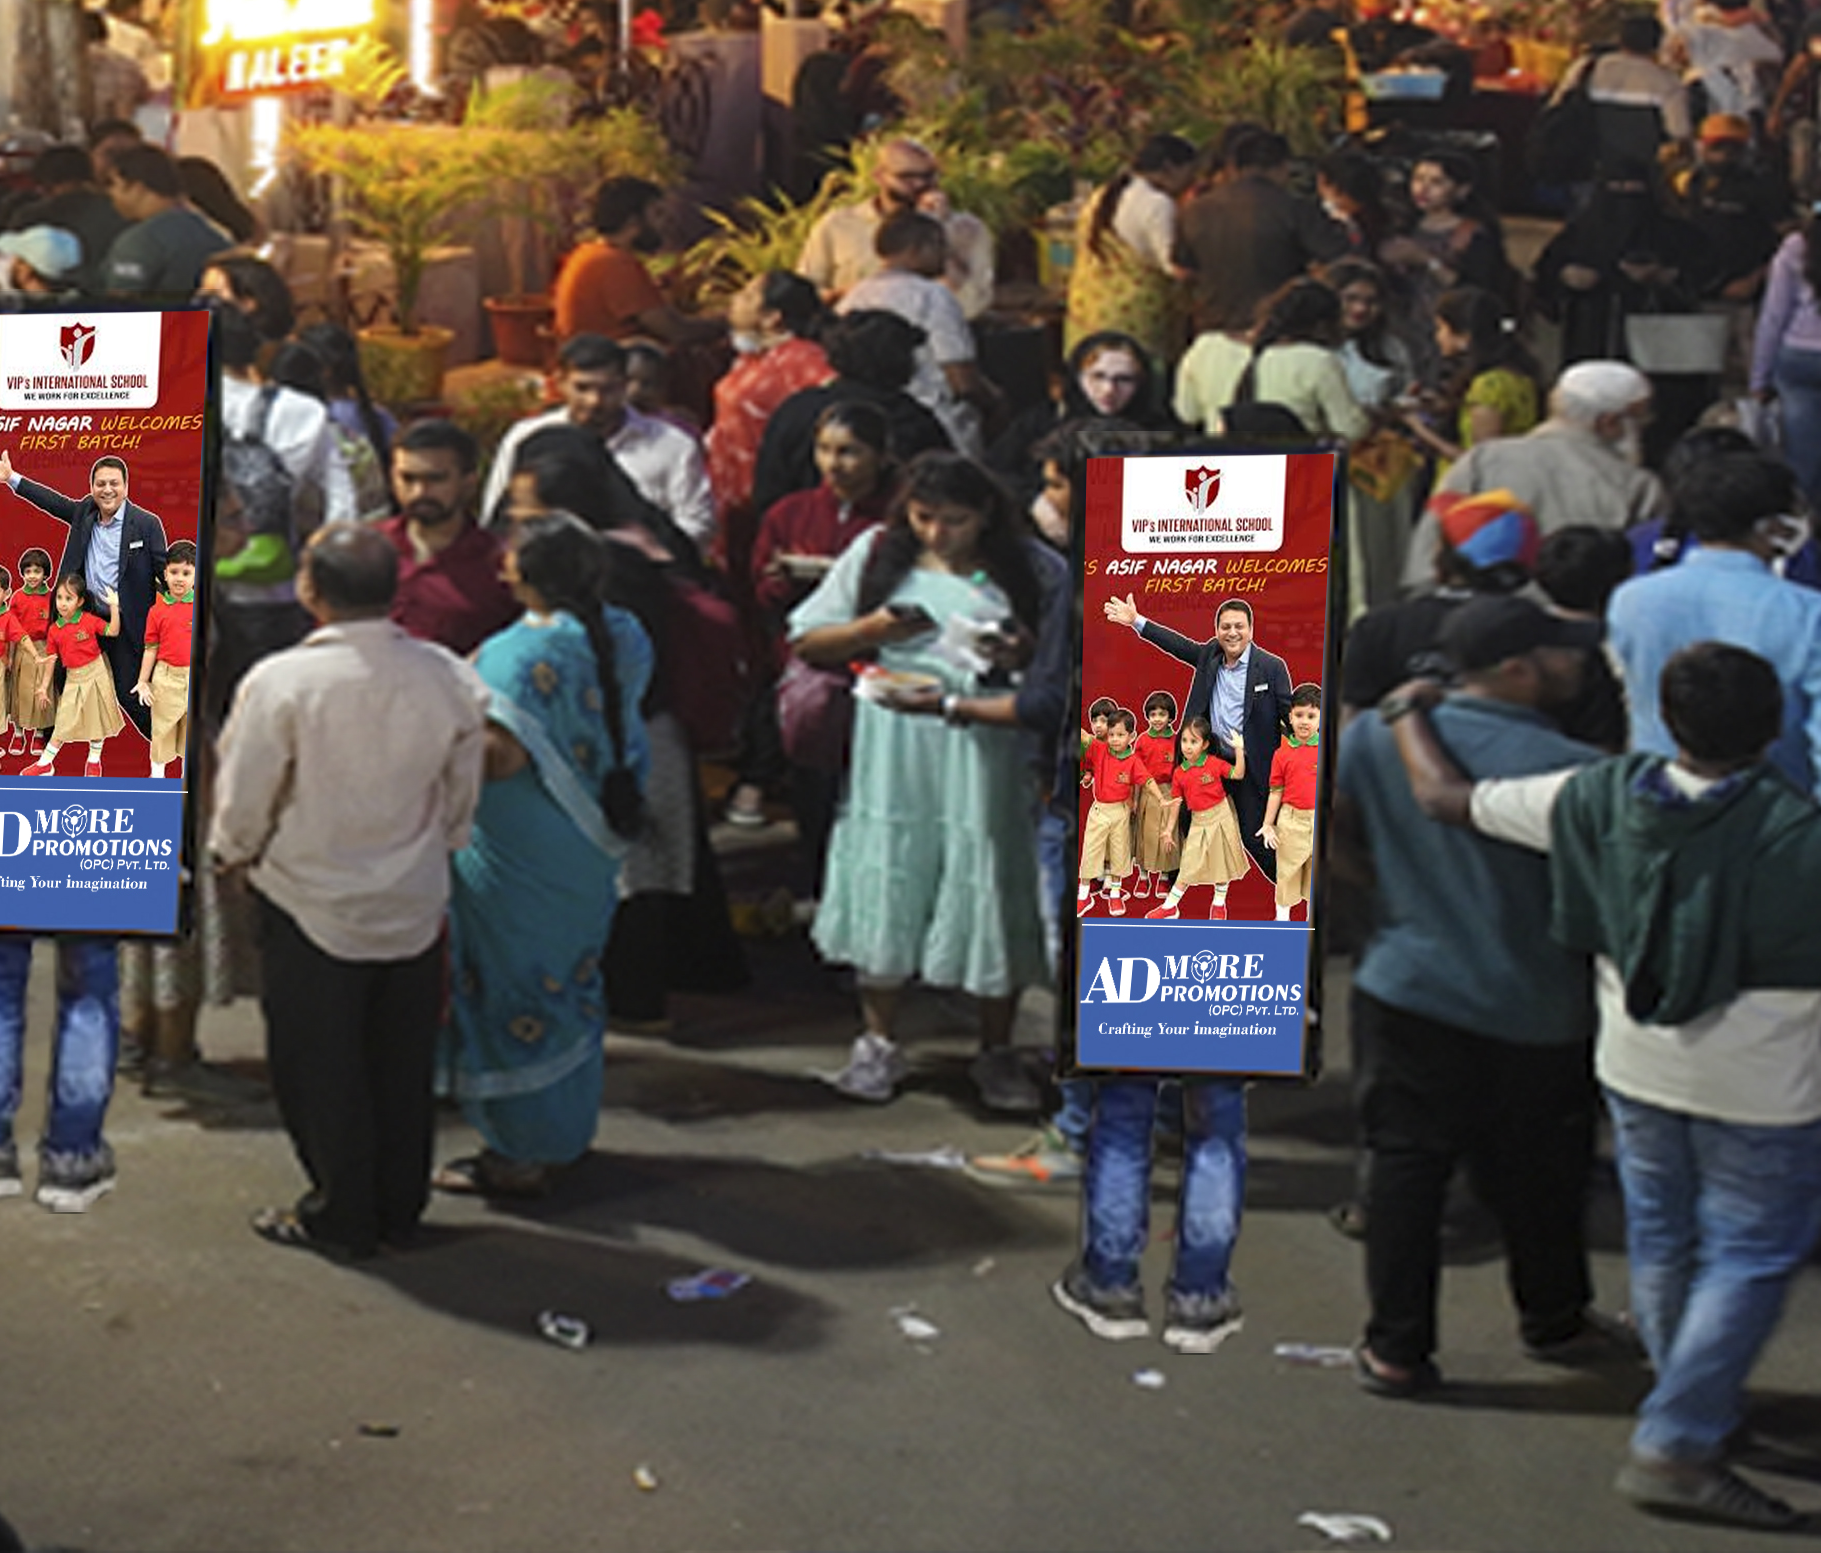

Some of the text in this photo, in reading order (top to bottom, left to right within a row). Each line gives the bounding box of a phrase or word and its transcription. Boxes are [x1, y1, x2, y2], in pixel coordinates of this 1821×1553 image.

[7, 375, 148, 390] VIP's INTERNATIONAL SCHOOL
[24, 391, 130, 401] WE WORK FOR EXCELLENCE
[27, 415, 93, 432] NAGAR
[101, 414, 203, 431] WELCOMES
[20, 435, 142, 450] FIRST BATCH!
[1132, 518, 1273, 533] VIP's INTERNATIONAL SCHOOL
[1149, 534, 1255, 544] WE WORK FOR EXCELLENCE
[1105, 559, 1147, 575] ASIF
[1152, 558, 1218, 575] NAGAR
[1226, 557, 1328, 574] WELCOMES
[1145, 578, 1267, 593] FIRST BATCH!
[32, 838, 172, 857] PROMOTIONS
[79, 858, 114, 870] (OPC)
[30, 875, 62, 888] Your
[1160, 983, 1302, 1002] PROMOTIONS
[1208, 1004, 1243, 1016] (OPC)
[1098, 1022, 1153, 1038] Crafting
[1158, 1022, 1190, 1035] Your
